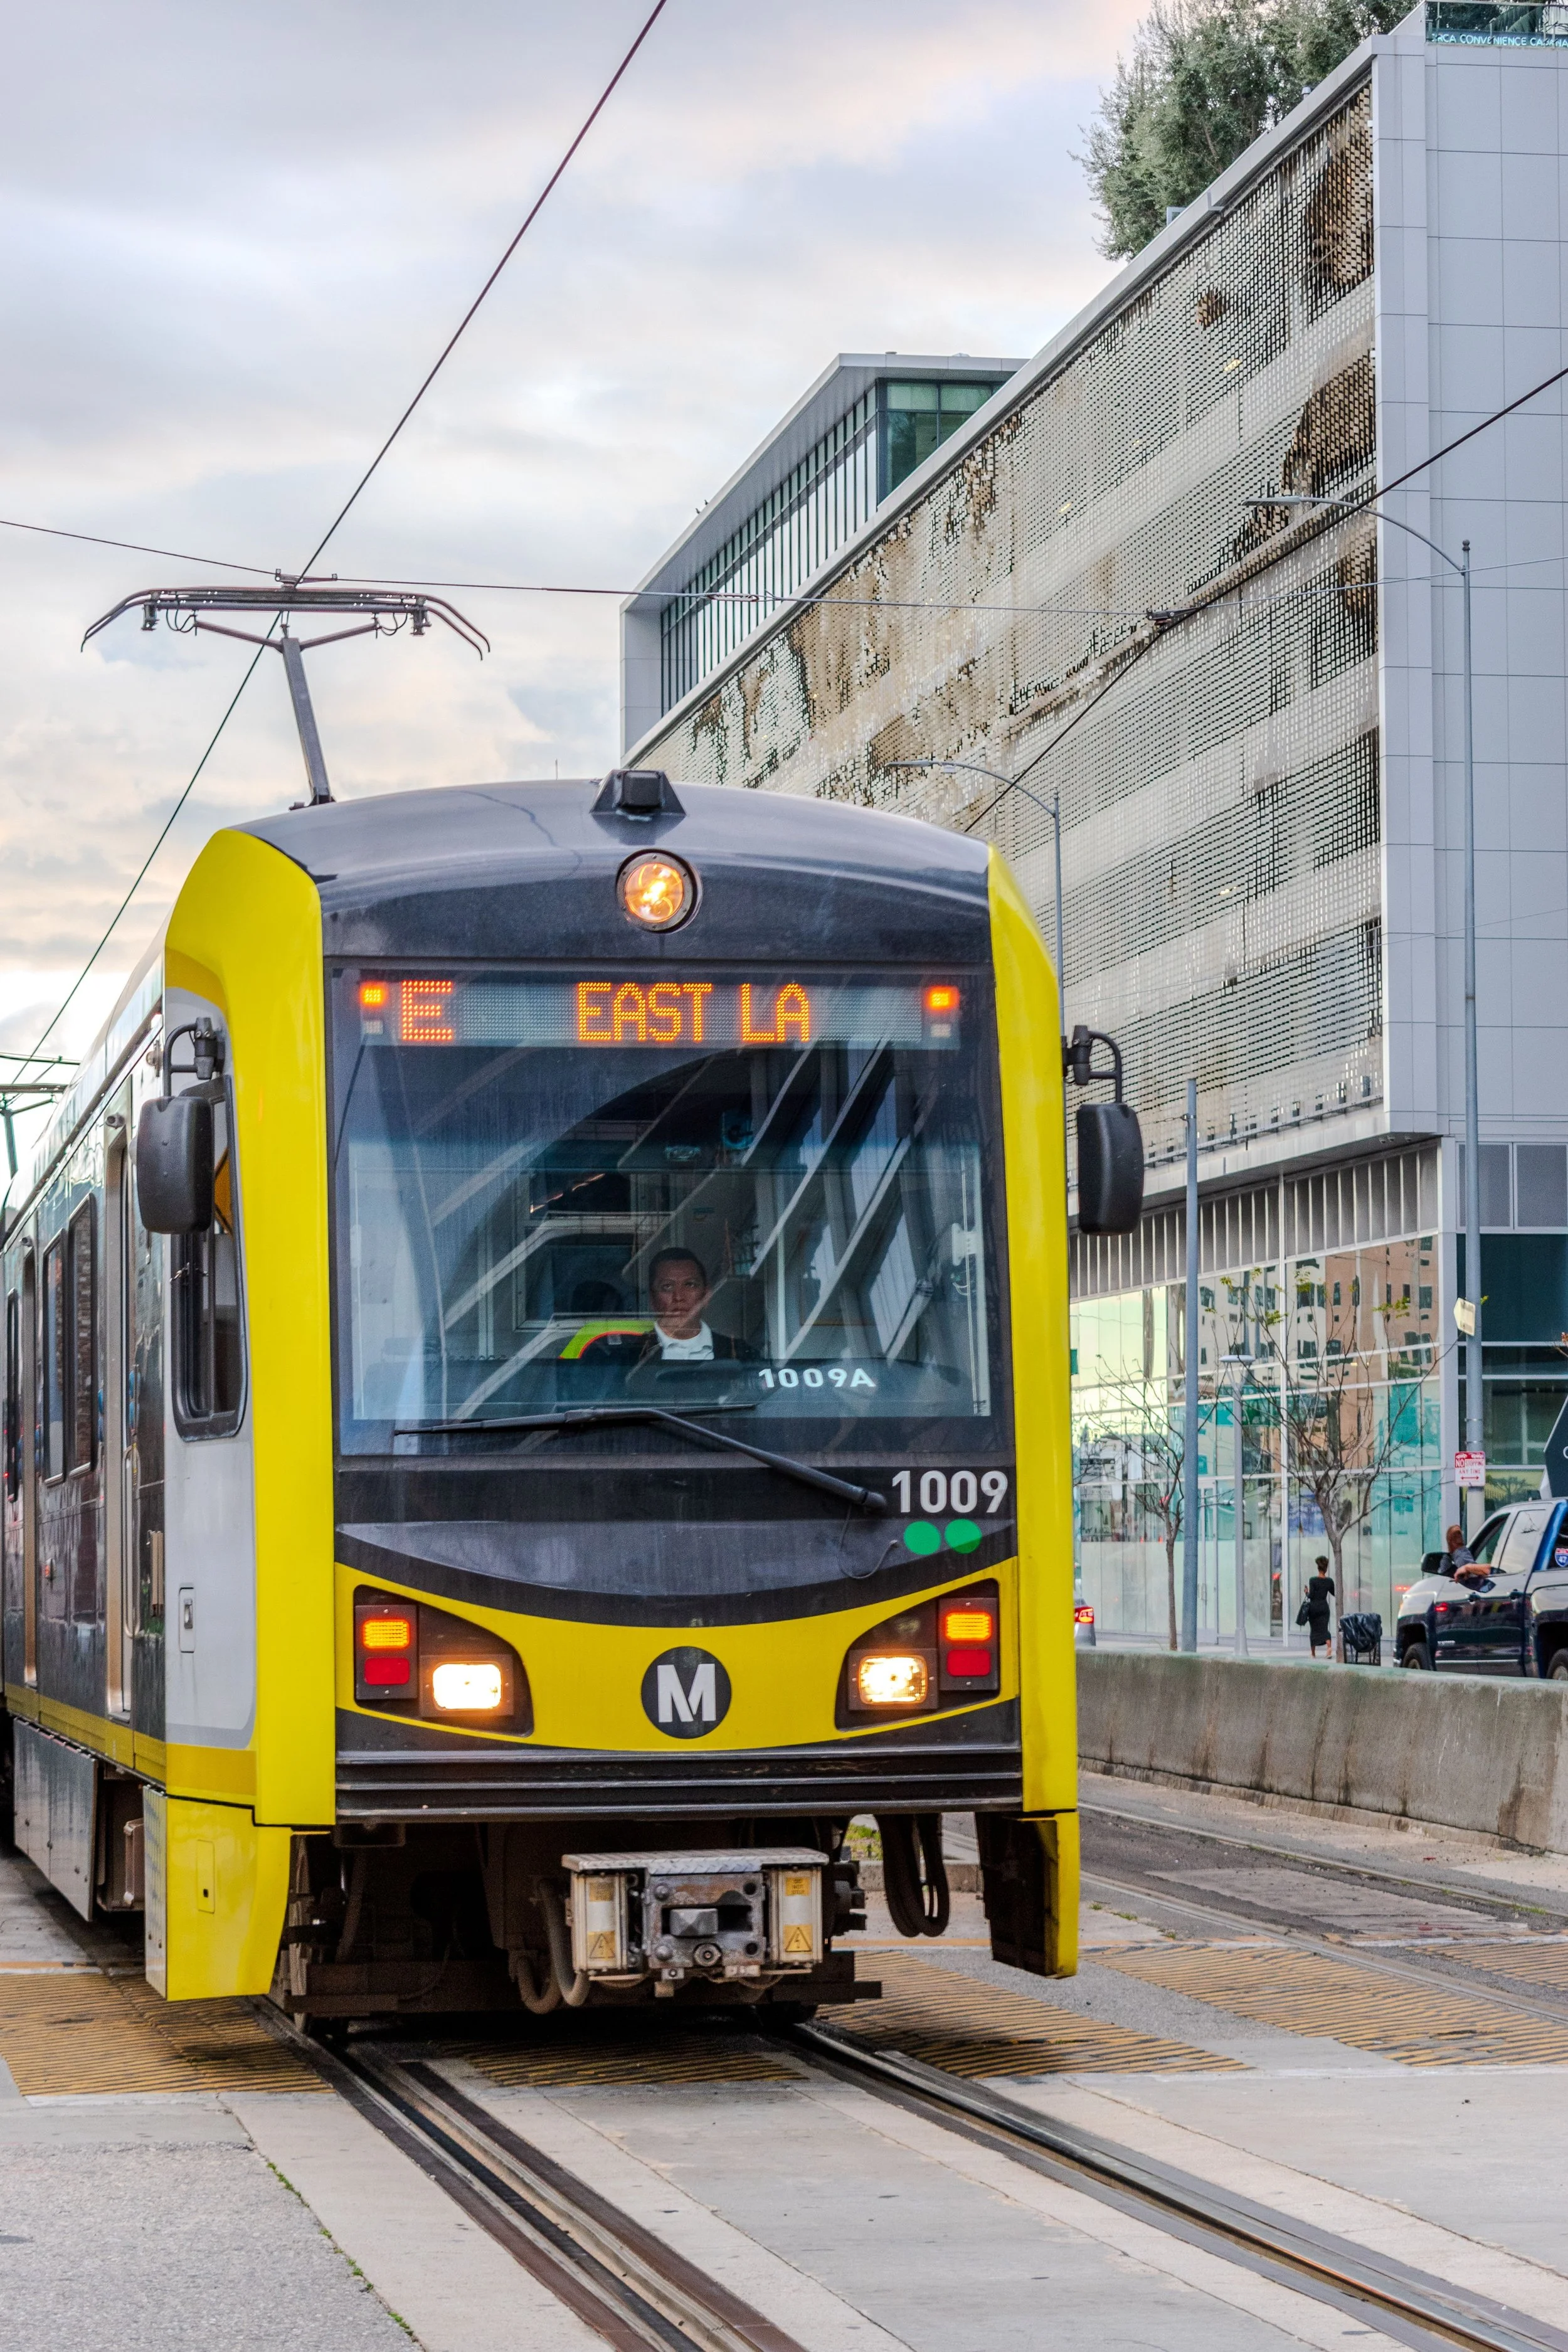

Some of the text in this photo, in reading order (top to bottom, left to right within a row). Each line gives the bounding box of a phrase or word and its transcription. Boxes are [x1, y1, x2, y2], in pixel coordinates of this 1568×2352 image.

[1459, 34, 1527, 46] CONVENIENCE
[402, 980, 810, 1042] E EAST LA
[758, 1368, 876, 1388] 1009A
[1456, 1459, 1465, 1467] NO
[892, 1470, 1008, 1513] 1009
[657, 1663, 716, 1722] M
